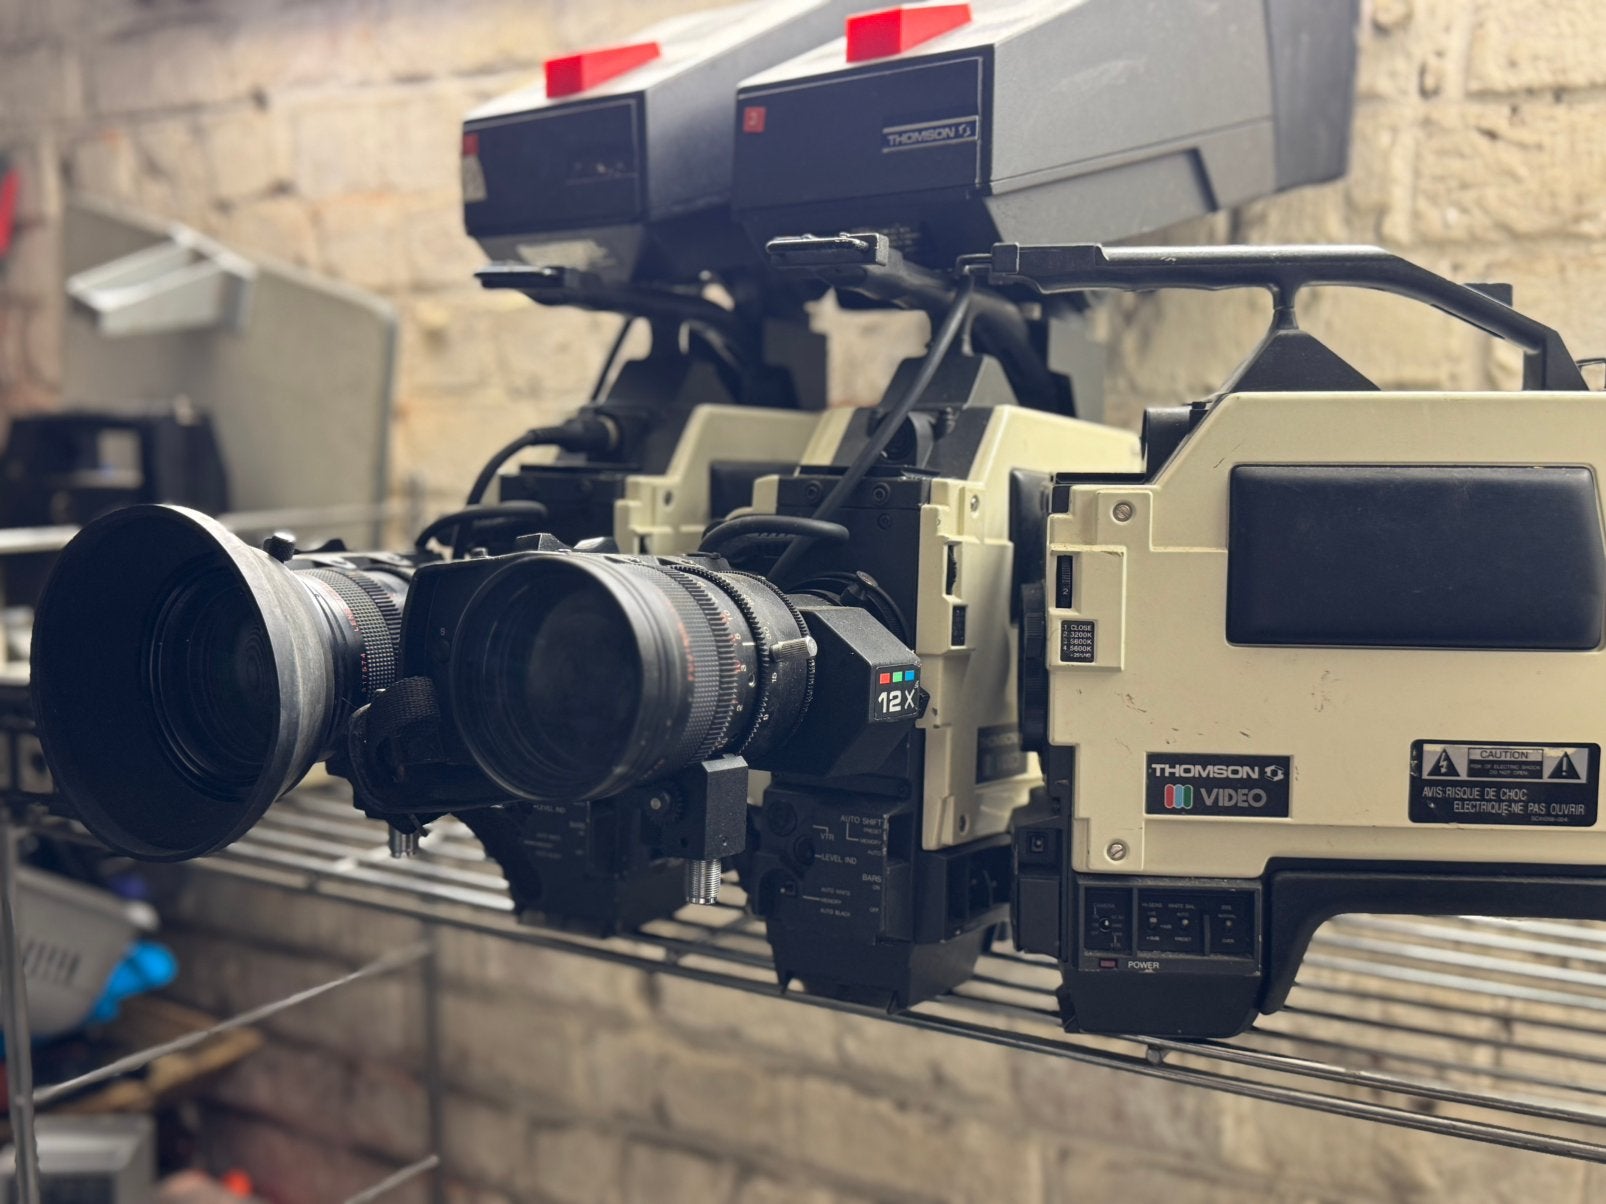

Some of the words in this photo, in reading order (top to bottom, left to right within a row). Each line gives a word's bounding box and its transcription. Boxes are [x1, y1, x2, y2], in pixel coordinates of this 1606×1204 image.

[887, 125, 956, 146] THOMSON
[1480, 750, 1529, 760] CAUTION
[1151, 763, 1259, 779] THOMSON
[1200, 788, 1267, 807] VIDEO
[1484, 787, 1497, 800] DE
[1500, 788, 1528, 801] CHOC
[1527, 803, 1546, 815] PAS
[1550, 804, 1585, 816] OUVRIR
[840, 815, 860, 824] AUTO
[862, 817, 882, 827] SHIFT
[821, 853, 843, 863] LEVEL
[844, 856, 857, 865] IND
[862, 873, 882, 883] BARS
[1127, 960, 1160, 970] POWER
